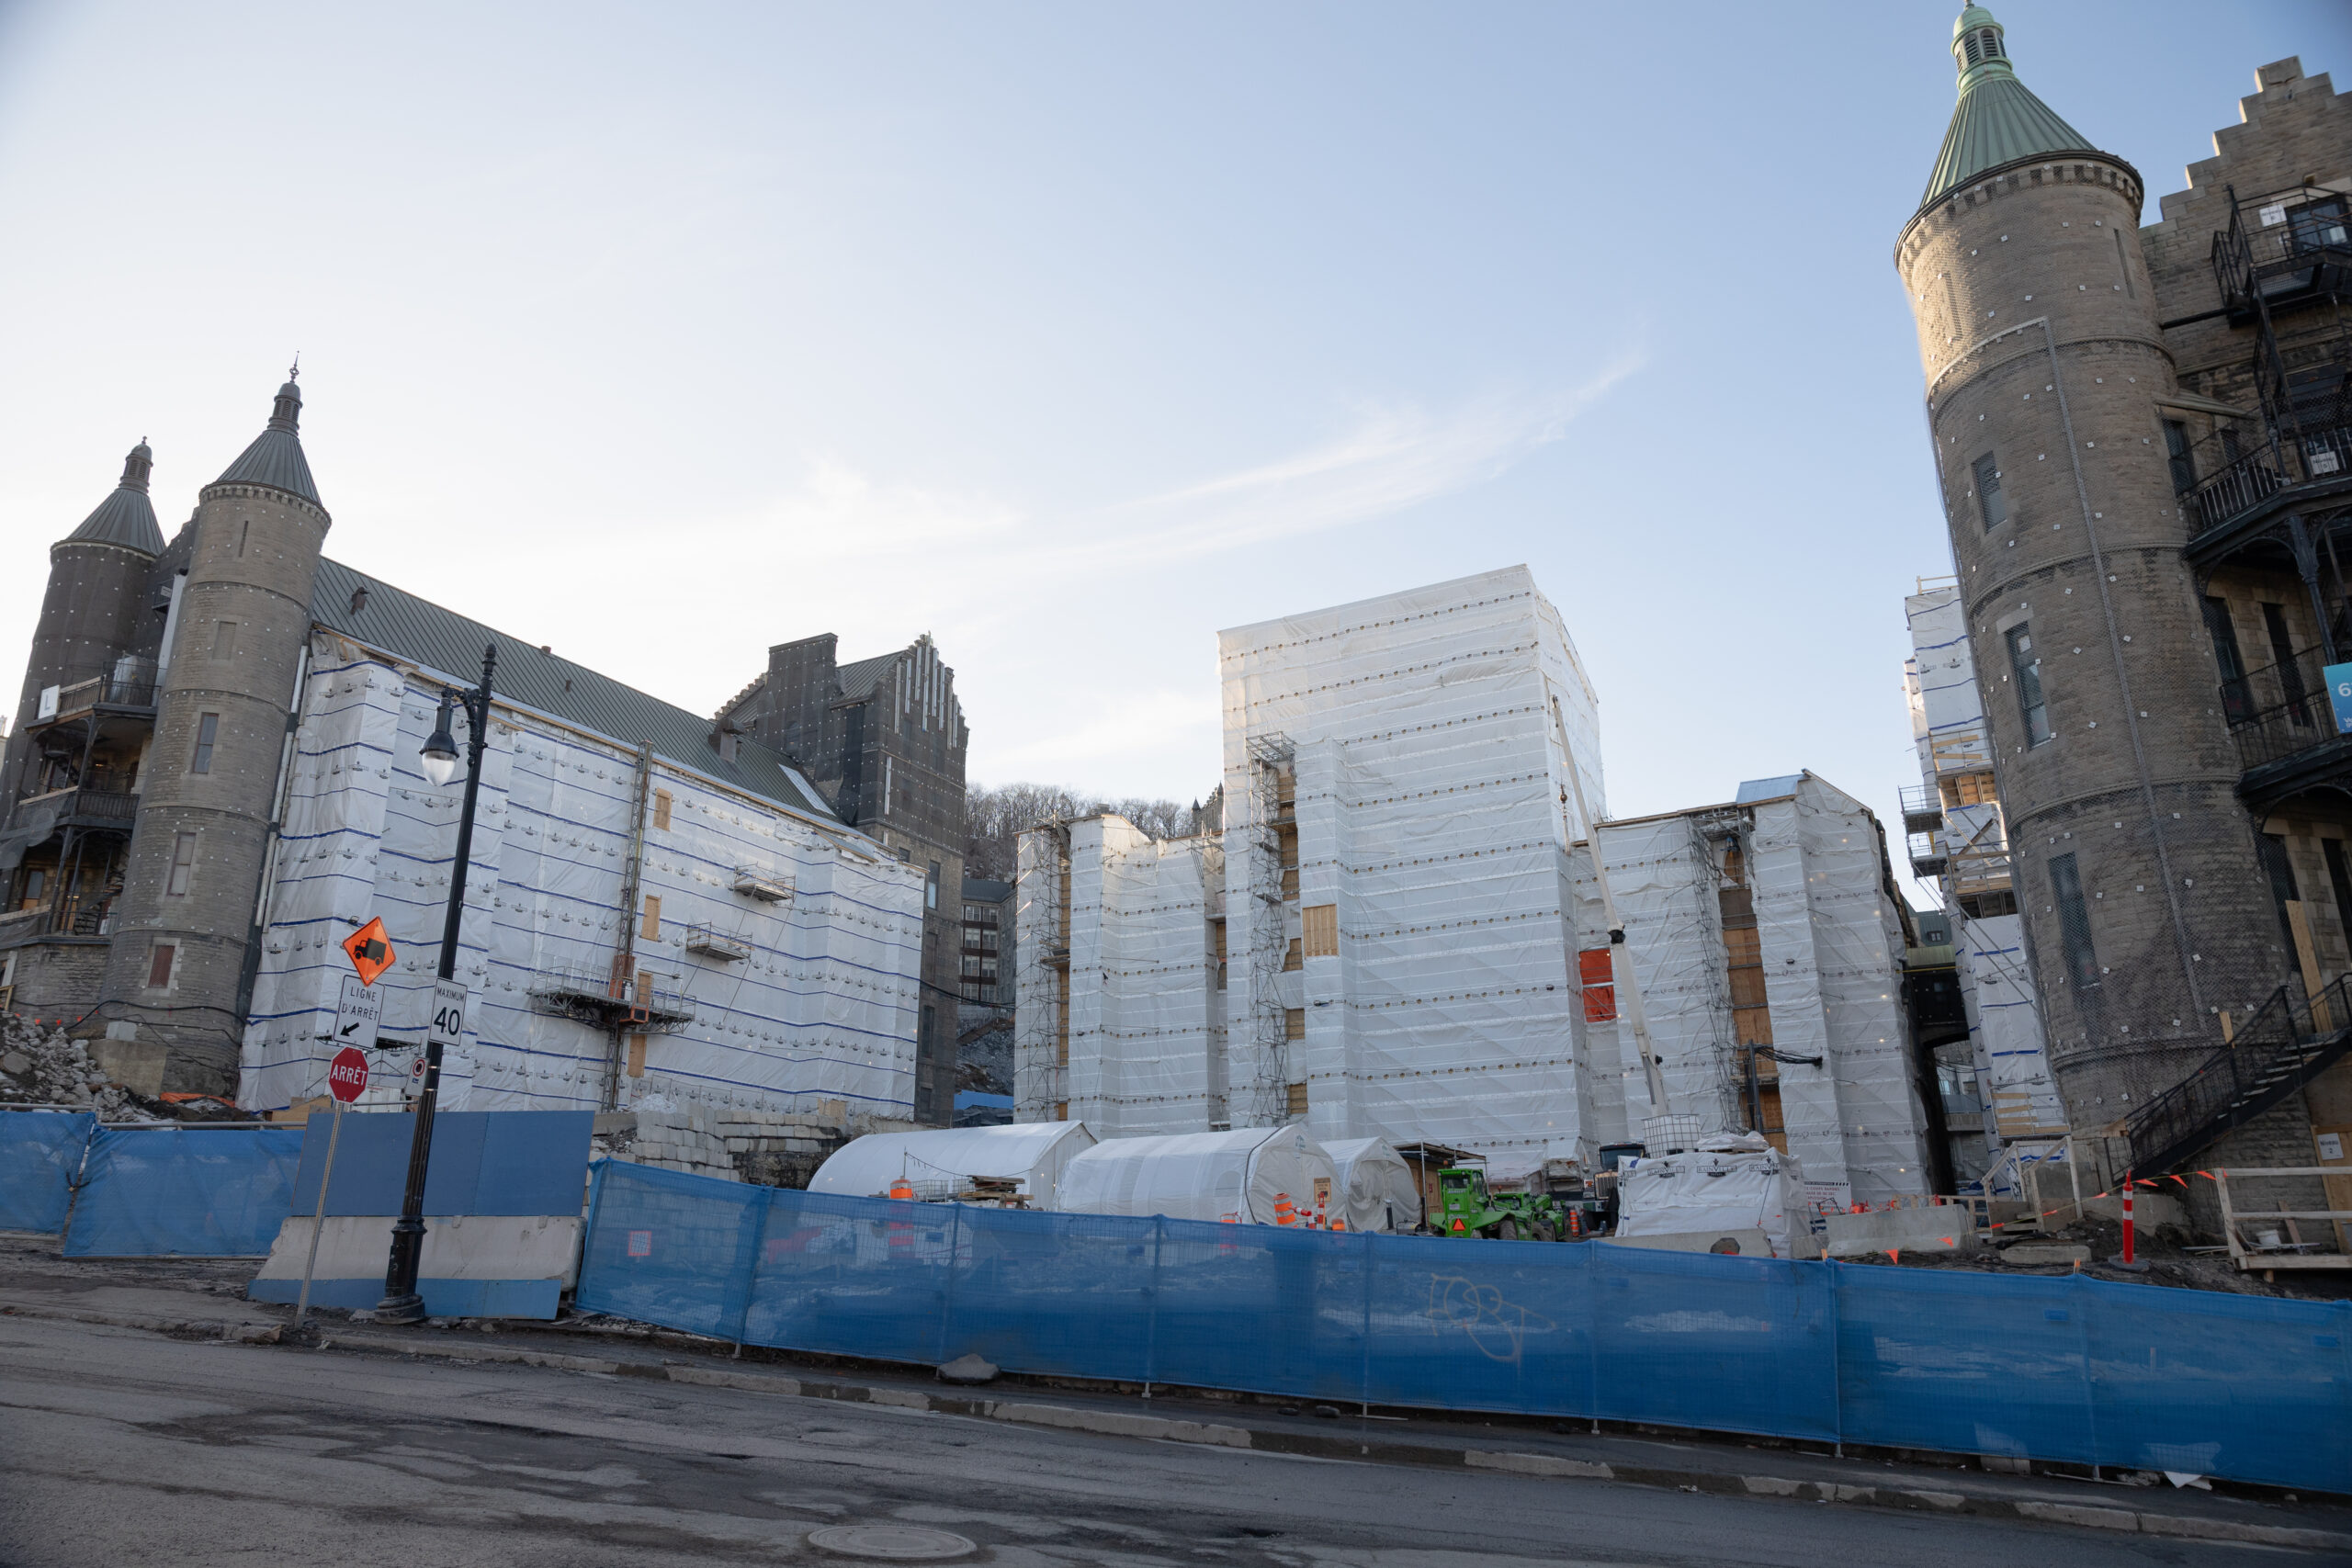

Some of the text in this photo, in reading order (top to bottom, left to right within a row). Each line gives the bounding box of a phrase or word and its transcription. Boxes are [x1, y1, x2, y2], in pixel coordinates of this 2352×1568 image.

[2338, 682, 2352, 697] 6
[350, 986, 377, 1002] LIGNE
[436, 987, 465, 1002] MAXIMUM
[341, 1002, 379, 1021] D'ARRÊT
[434, 1007, 460, 1035] 40
[331, 1066, 368, 1086] ARRÊT
